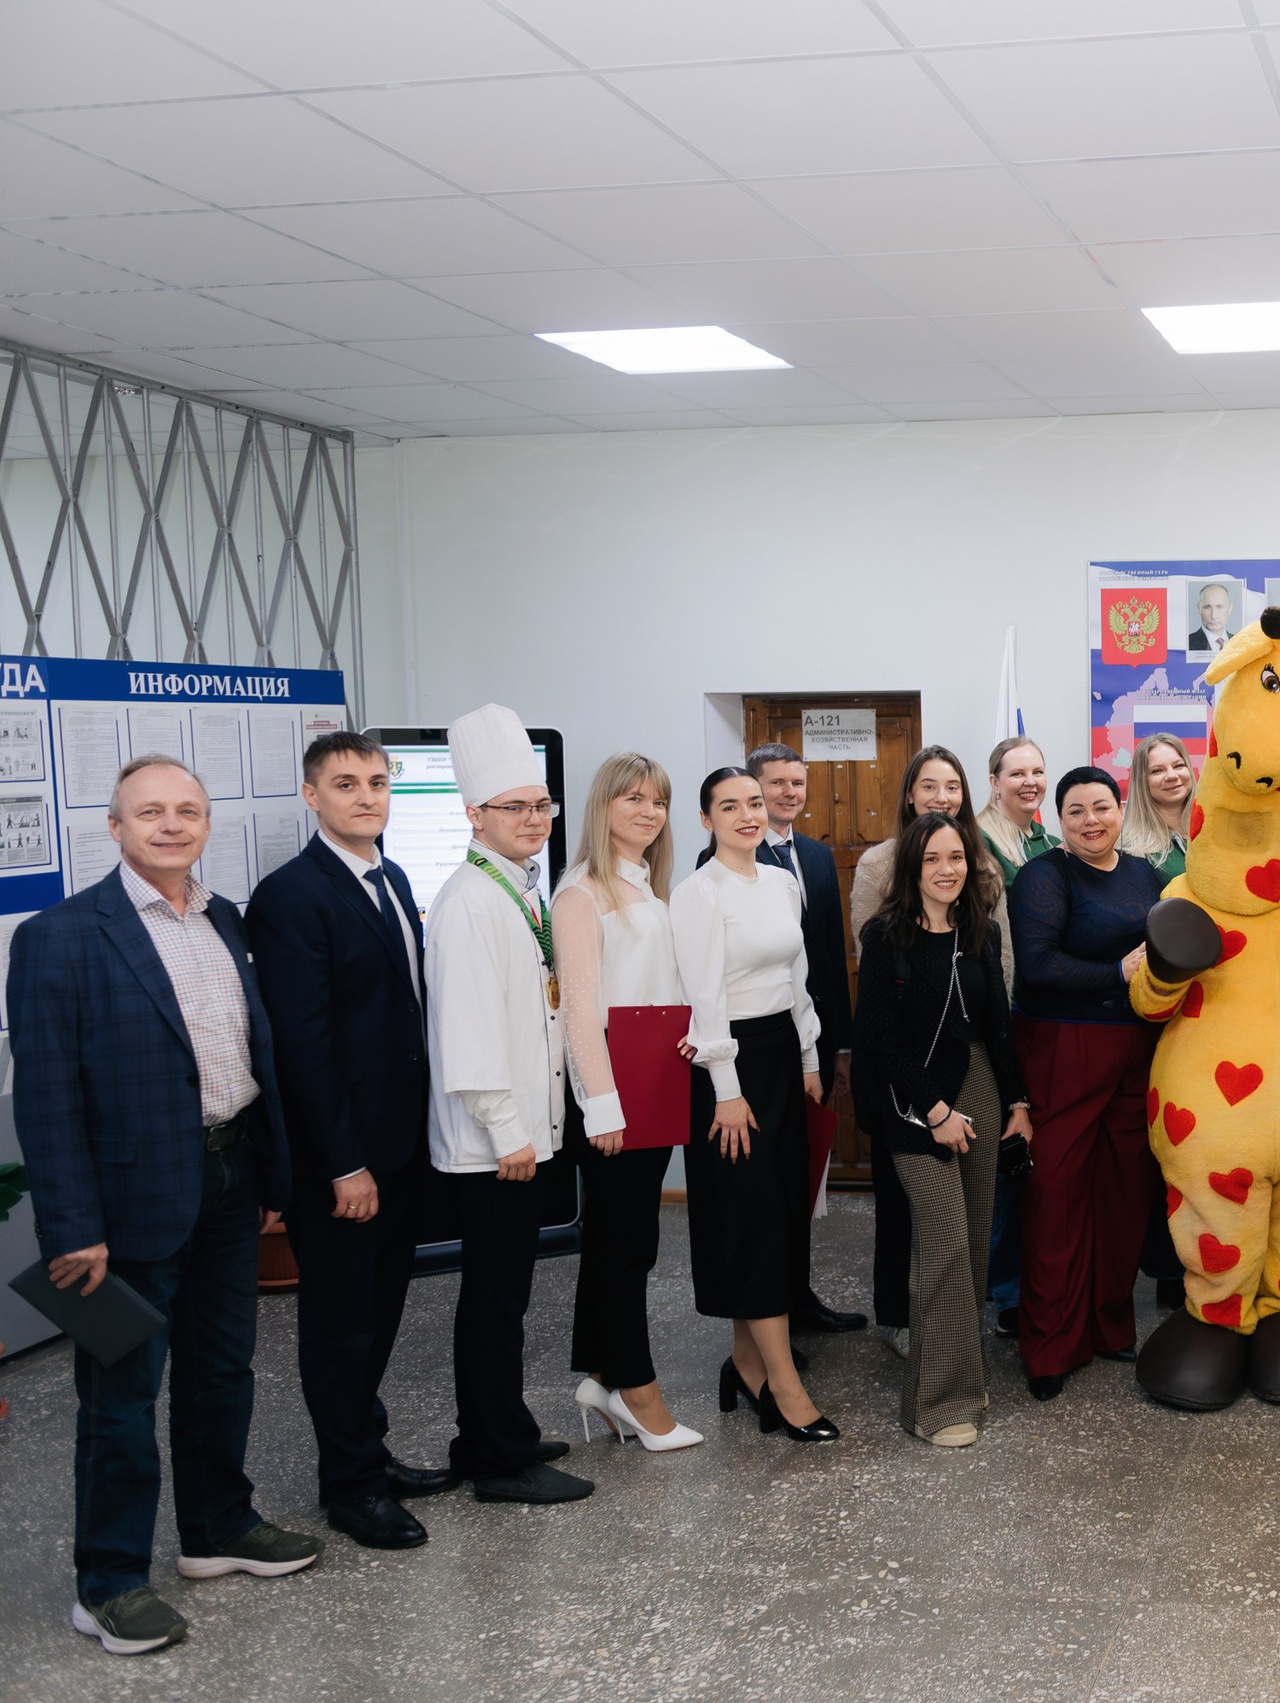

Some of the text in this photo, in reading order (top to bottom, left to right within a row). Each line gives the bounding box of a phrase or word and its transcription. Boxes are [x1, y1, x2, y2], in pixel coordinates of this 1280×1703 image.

[0, 662, 46, 697] ДА
[128, 671, 291, 701] ИНФОРМАЦИЯ
[804, 715, 840, 726] А-121
